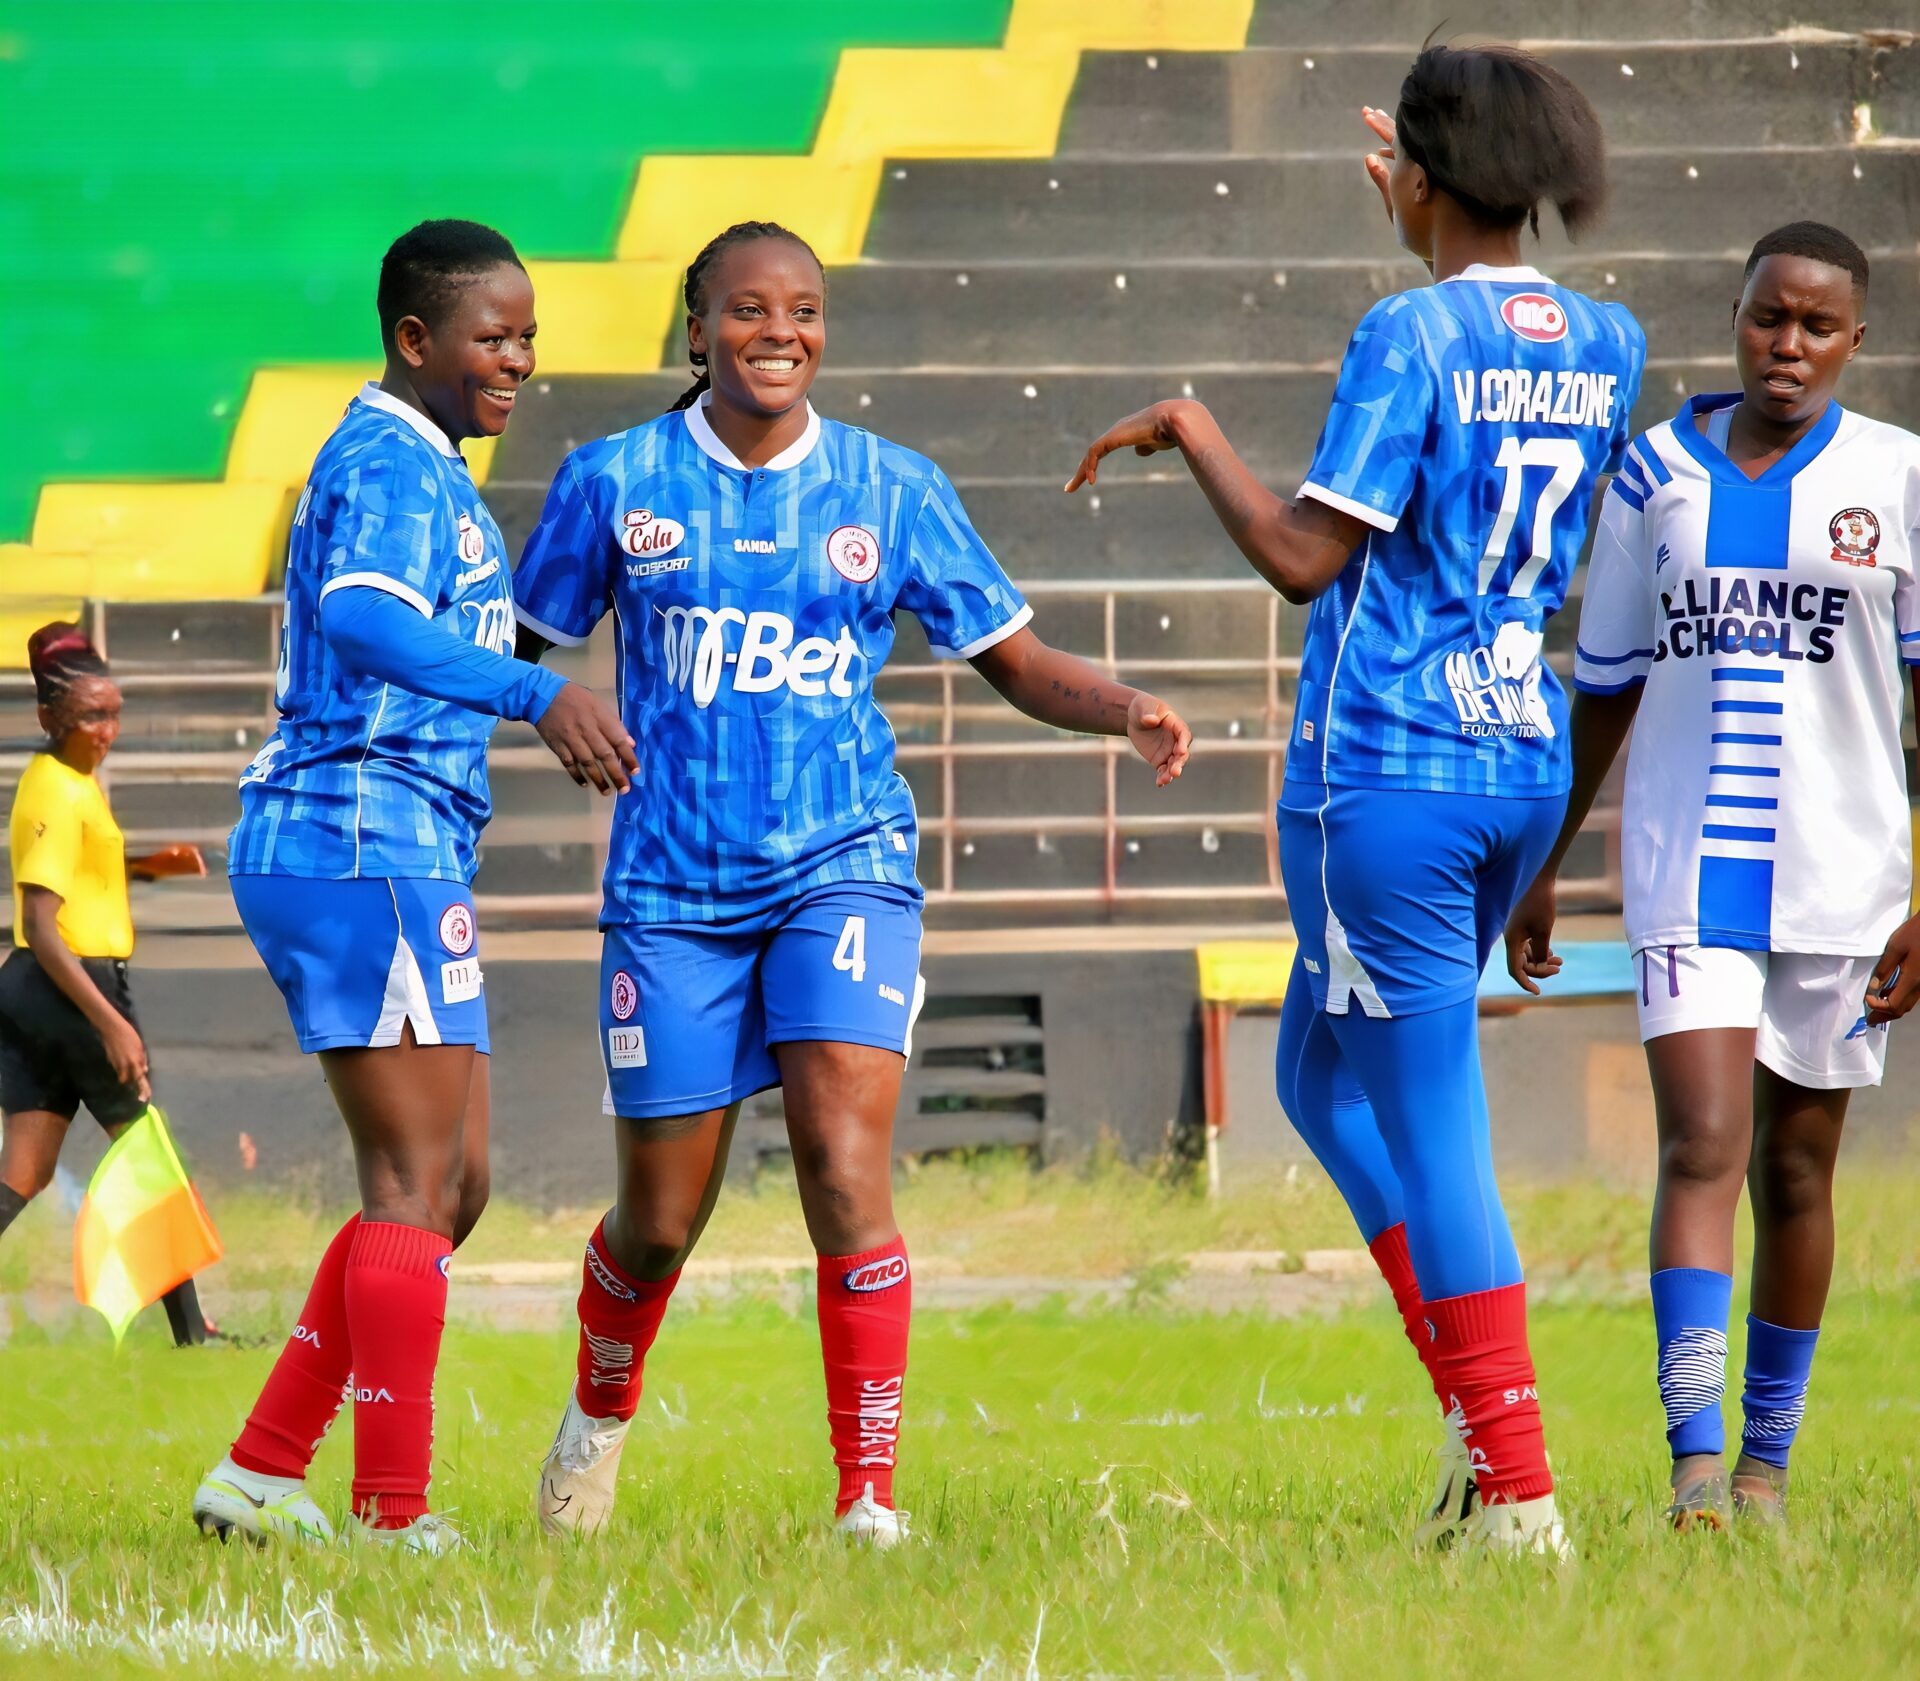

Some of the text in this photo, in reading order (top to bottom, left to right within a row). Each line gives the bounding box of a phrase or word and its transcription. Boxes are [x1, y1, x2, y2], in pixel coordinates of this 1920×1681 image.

[1453, 368, 1618, 429] V.CORAZONE
[1478, 436, 1585, 598] 17
[626, 557, 693, 577] MOSPORT
[734, 538, 777, 554] SANDA
[1445, 646, 1497, 692] MO
[832, 916, 866, 982] 4
